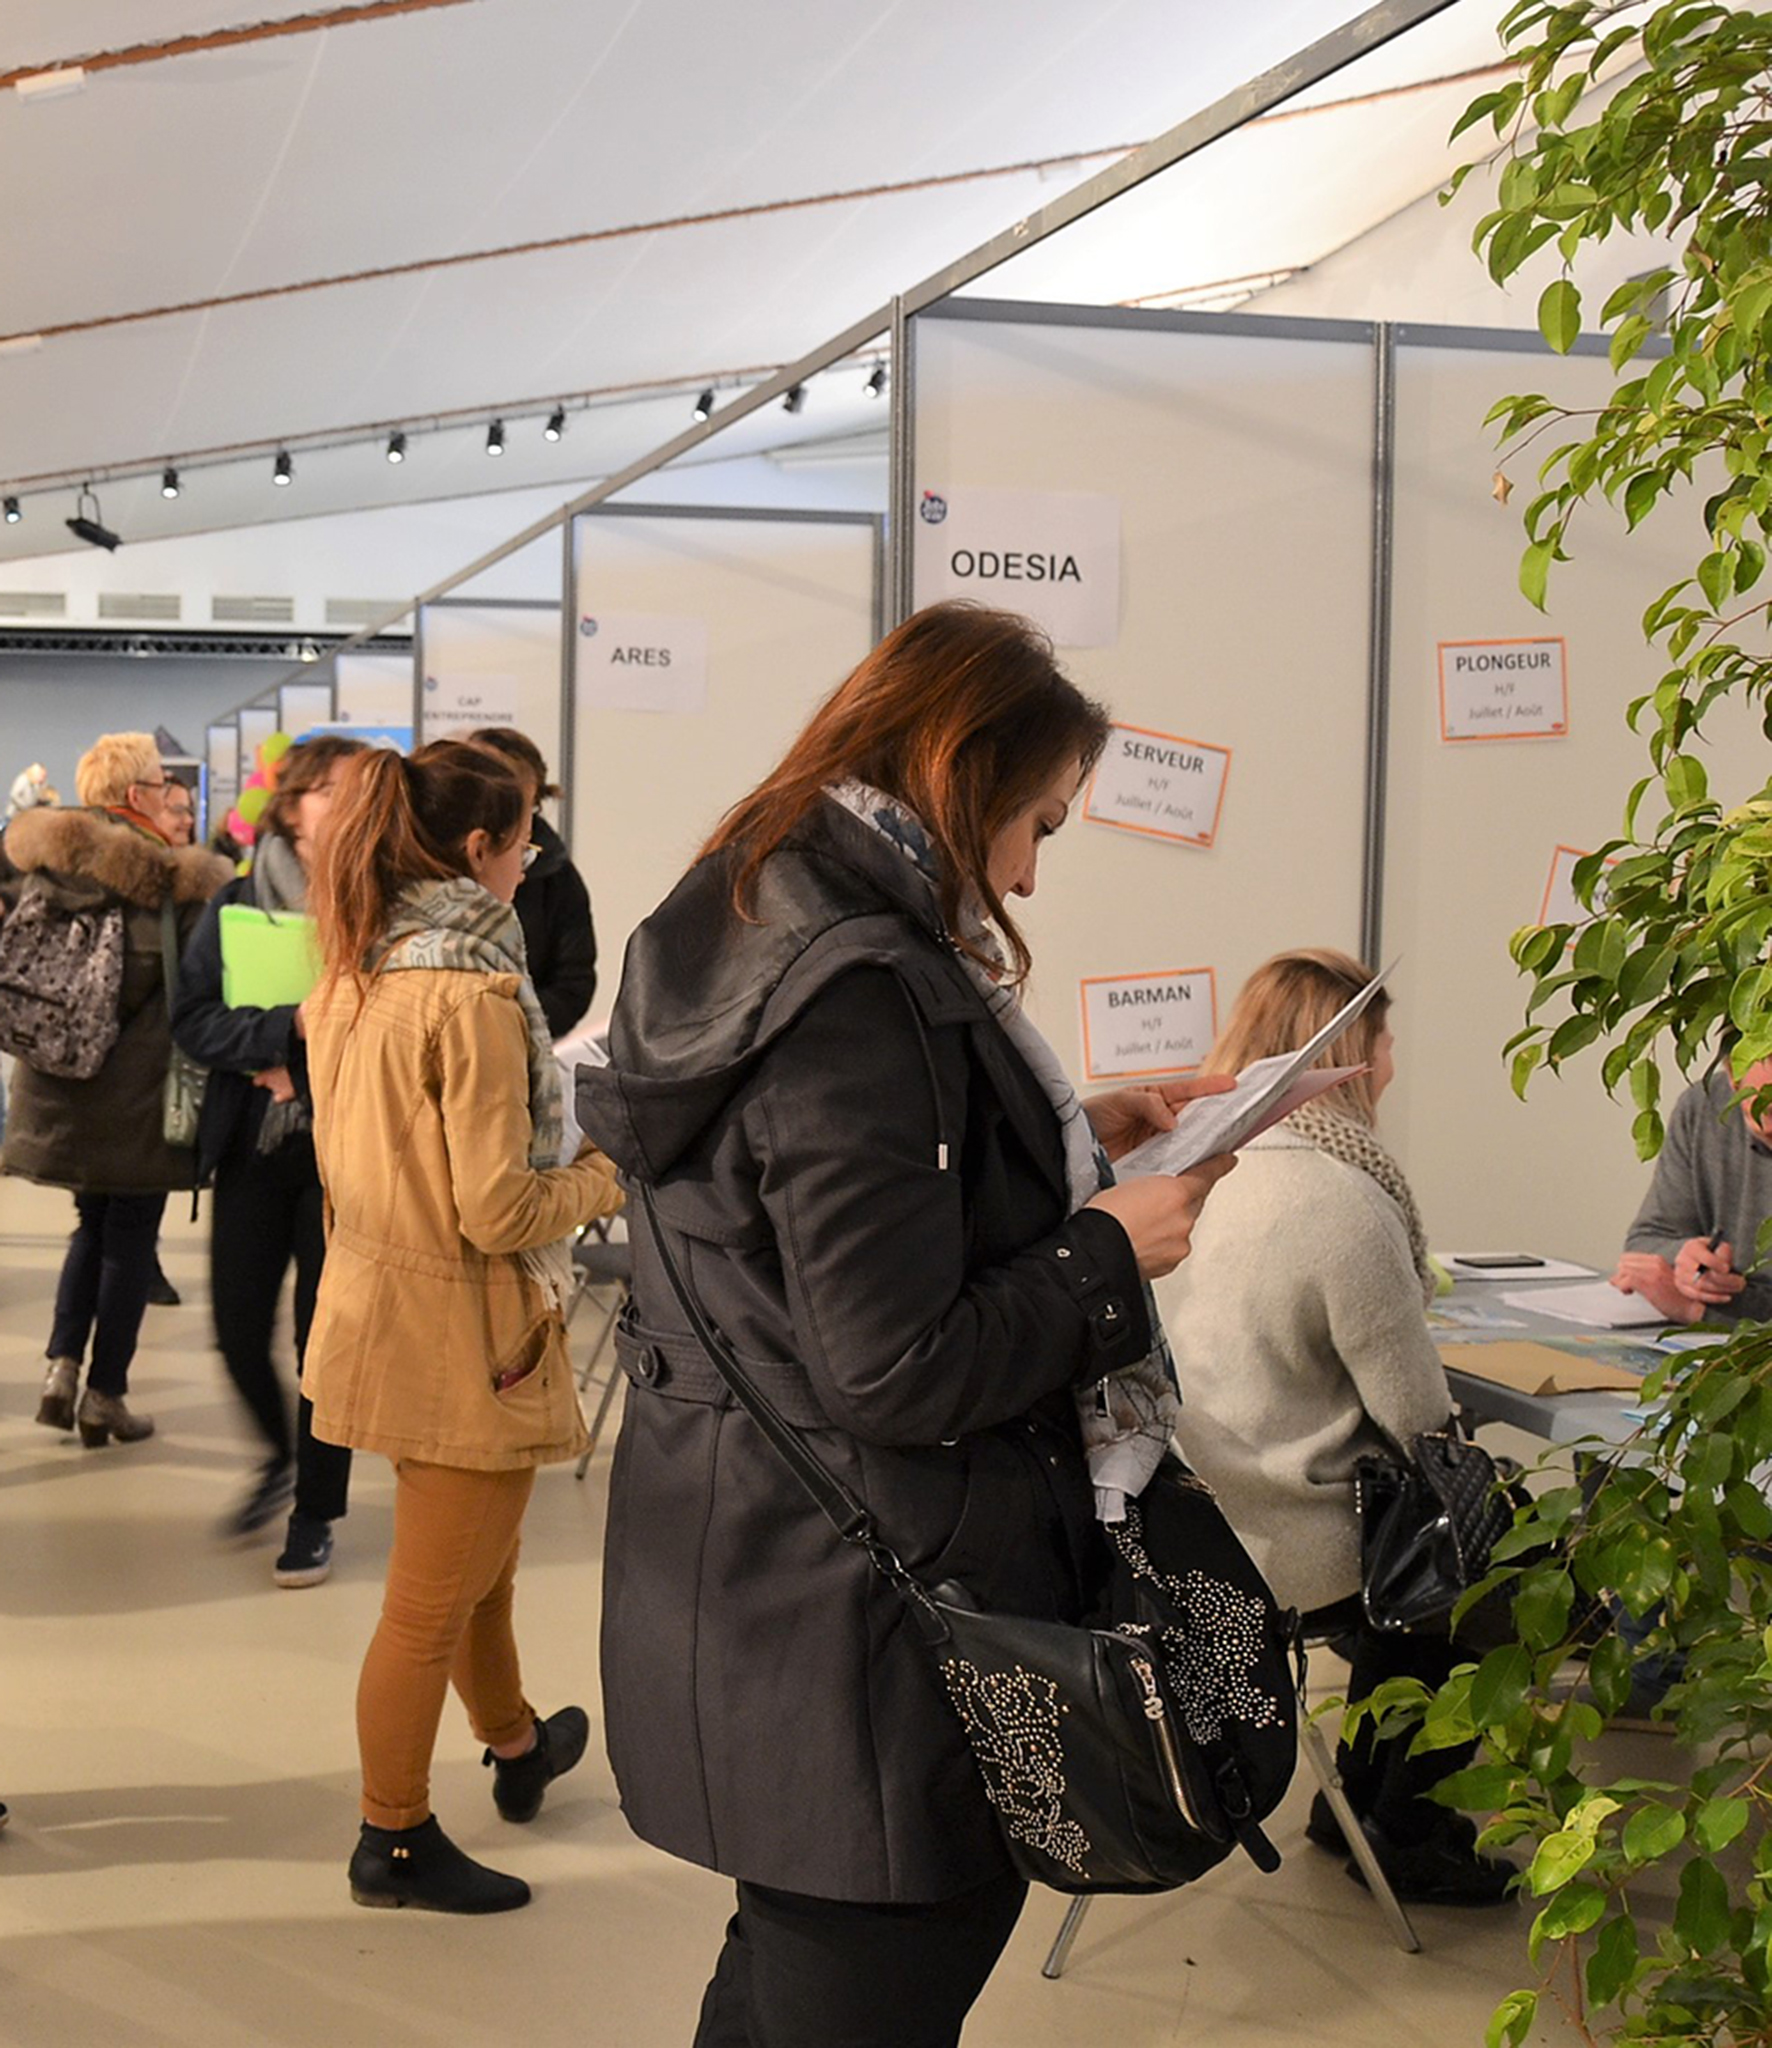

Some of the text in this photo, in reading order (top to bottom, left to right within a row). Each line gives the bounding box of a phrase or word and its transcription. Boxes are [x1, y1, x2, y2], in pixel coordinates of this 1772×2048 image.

[951, 550, 1081, 582] ODESIA
[610, 646, 671, 668] ARES
[1456, 652, 1551, 672] PLONGEUR
[1494, 682, 1515, 696] H/F
[458, 696, 482, 706] CAP
[1468, 706, 1503, 719] Juillet
[1515, 703, 1543, 717] Août
[1122, 740, 1205, 773] SERVEUR
[1148, 776, 1170, 791] H/F
[1115, 793, 1152, 811] Juillet
[1108, 985, 1192, 1008] BARMAN
[1141, 1017, 1163, 1031] H/F
[1115, 1042, 1152, 1057] Juillet
